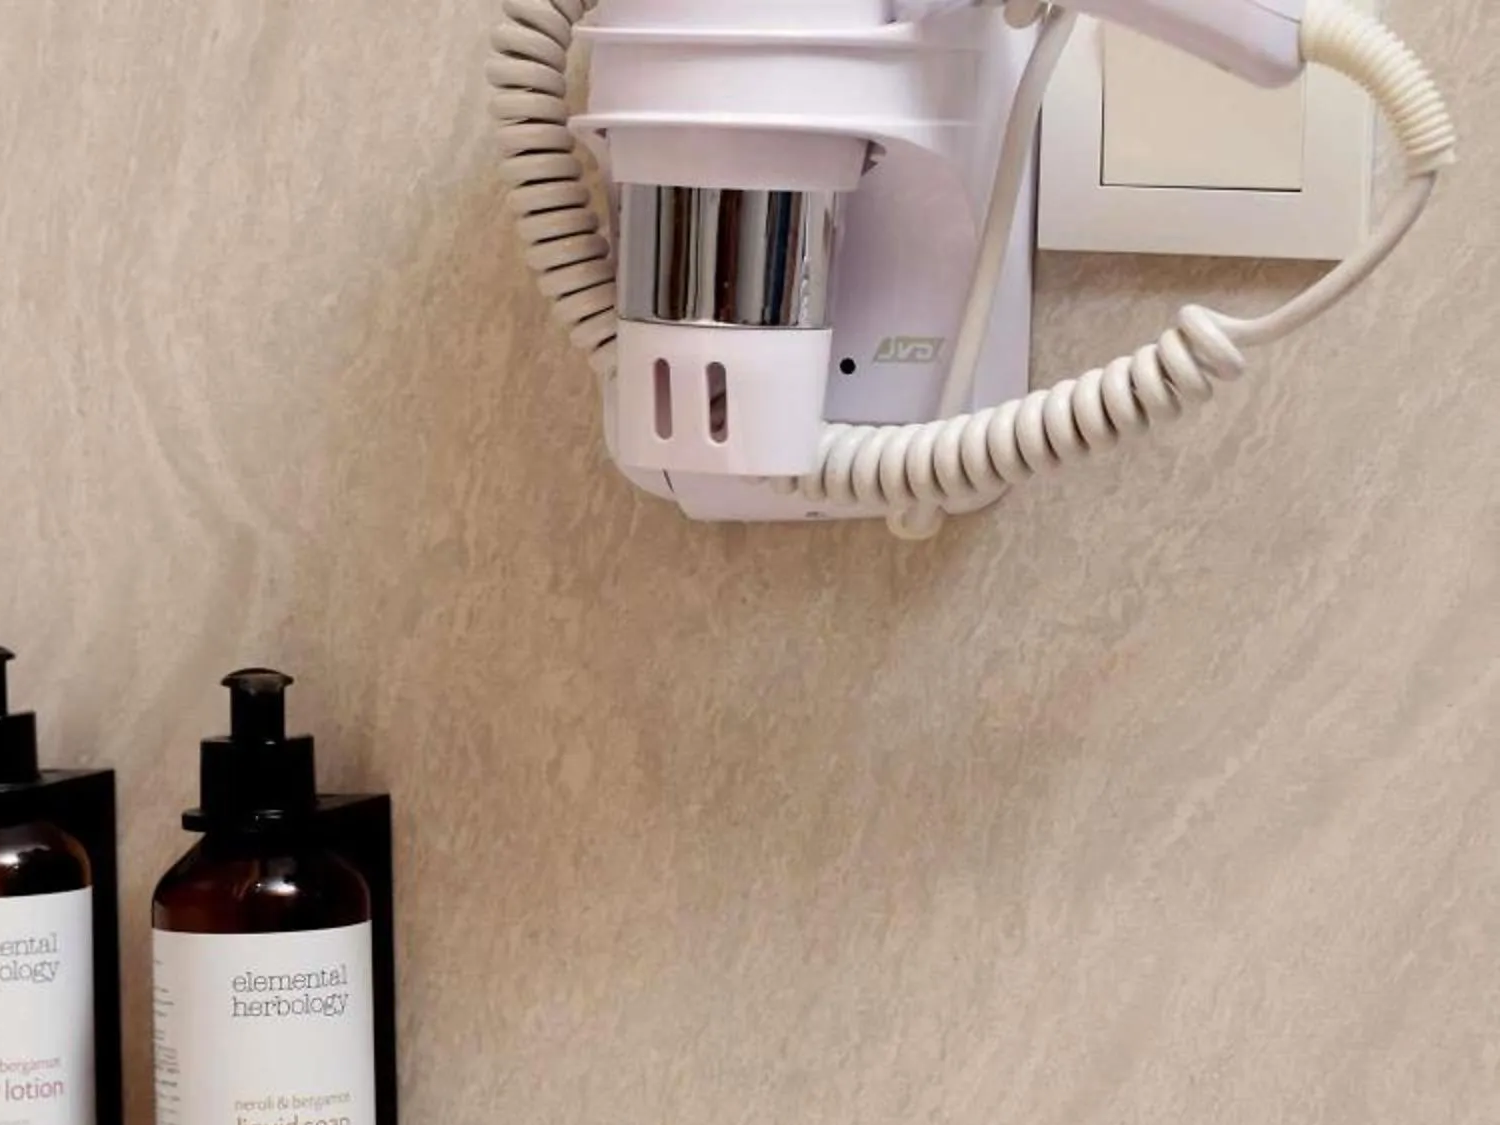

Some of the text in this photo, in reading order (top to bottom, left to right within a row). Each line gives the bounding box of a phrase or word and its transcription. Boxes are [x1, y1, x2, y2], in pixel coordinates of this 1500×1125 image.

[232, 963, 348, 993] elemental
[232, 994, 350, 1018] herbology
[5, 1076, 65, 1102] lotion
